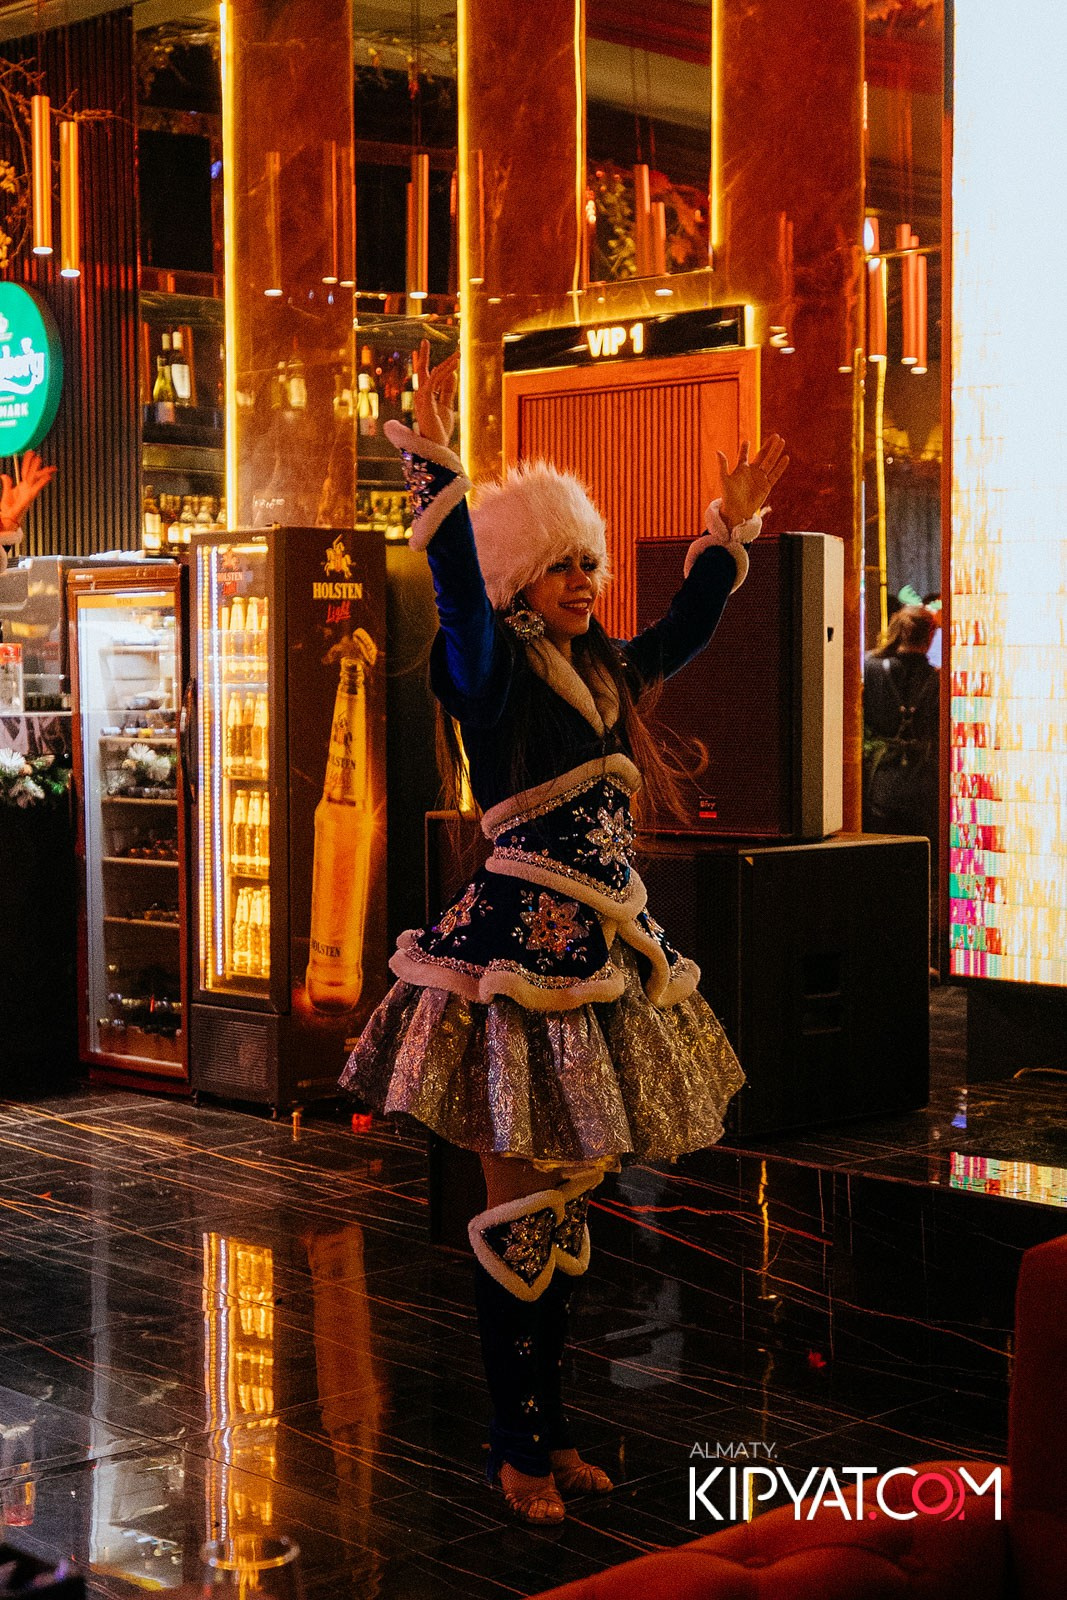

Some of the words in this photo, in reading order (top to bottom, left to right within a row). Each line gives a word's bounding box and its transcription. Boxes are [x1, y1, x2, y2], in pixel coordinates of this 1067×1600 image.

[587, 326, 626, 357] VIP
[630, 322, 644, 353] 1
[0, 402, 29, 418] MARK
[312, 582, 363, 599] HOLSTEN
